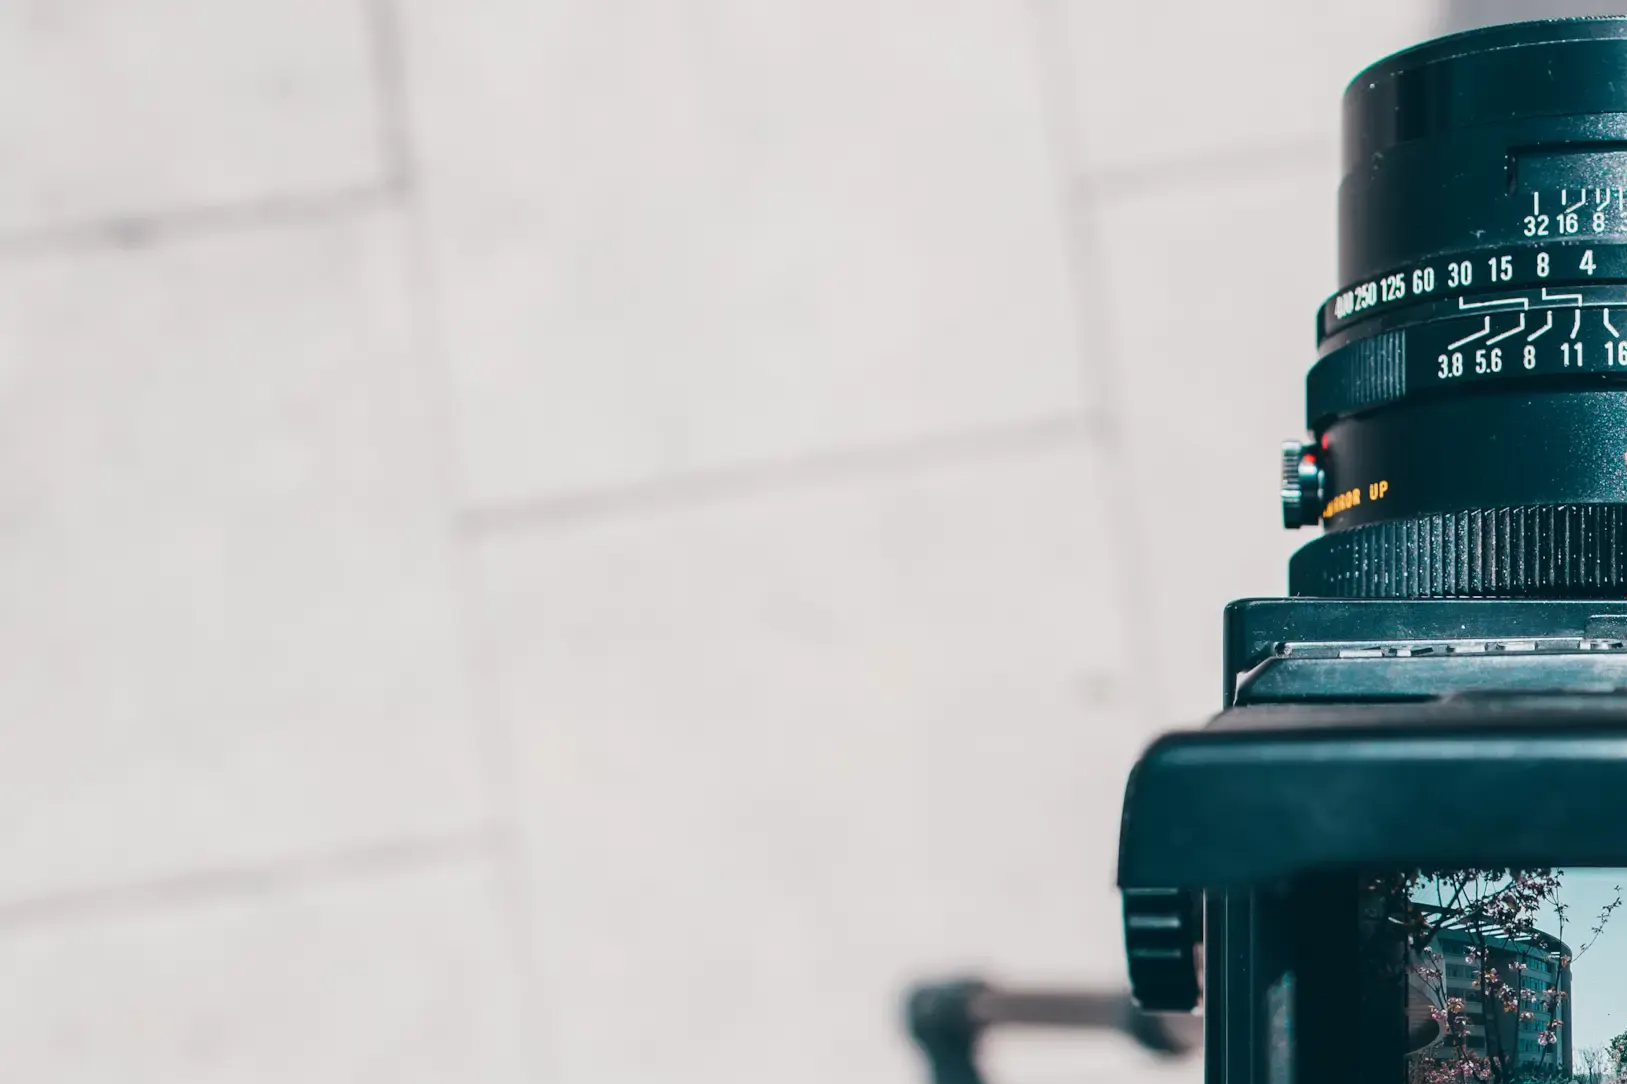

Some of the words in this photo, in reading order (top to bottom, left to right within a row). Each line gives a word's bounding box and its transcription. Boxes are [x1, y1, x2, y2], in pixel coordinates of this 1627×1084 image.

[1523, 216, 1549, 236] 32
[1557, 214, 1578, 233] 16
[1592, 213, 1605, 232] 8
[1354, 281, 1377, 311] 250
[1380, 273, 1406, 302] 125
[1412, 267, 1435, 294] 60
[1448, 260, 1473, 287] 30
[1488, 255, 1513, 282] 15
[1536, 251, 1550, 277] 8
[1579, 250, 1597, 275] 4
[1437, 352, 1463, 379] 3.8
[1475, 348, 1502, 374] 5.6
[1523, 345, 1536, 370] 8
[1561, 342, 1583, 367] 11
[1369, 479, 1389, 501] UP
